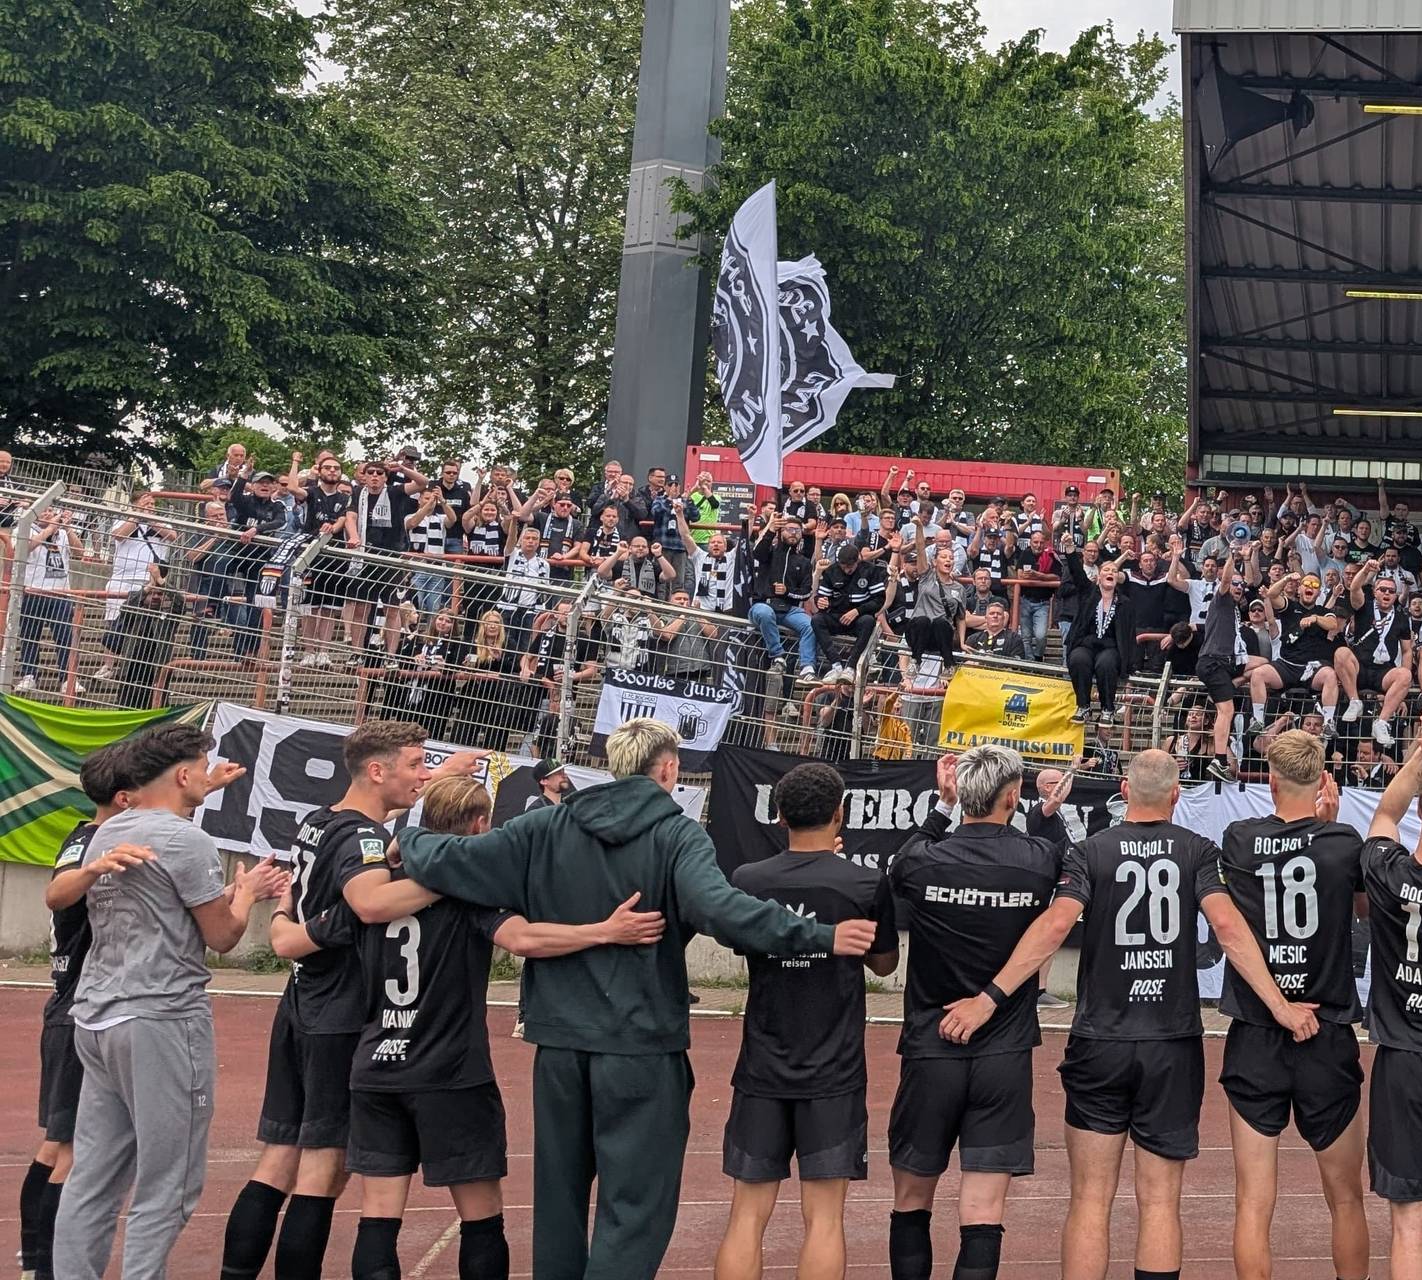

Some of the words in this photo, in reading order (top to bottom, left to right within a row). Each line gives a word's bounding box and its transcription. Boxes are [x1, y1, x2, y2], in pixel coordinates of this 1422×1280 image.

[946, 731, 1075, 756] PLATZHIRSCHE
[1120, 839, 1174, 859] BOCHOLT
[1254, 833, 1315, 855] BOCHOLT
[1115, 858, 1180, 946] 28
[1255, 855, 1319, 940] 18
[385, 915, 421, 1007] 3
[781, 958, 811, 968] reisen
[1120, 949, 1173, 970] JANSSEN
[1268, 945, 1307, 965] MESIC
[1129, 979, 1167, 996] ROSE
